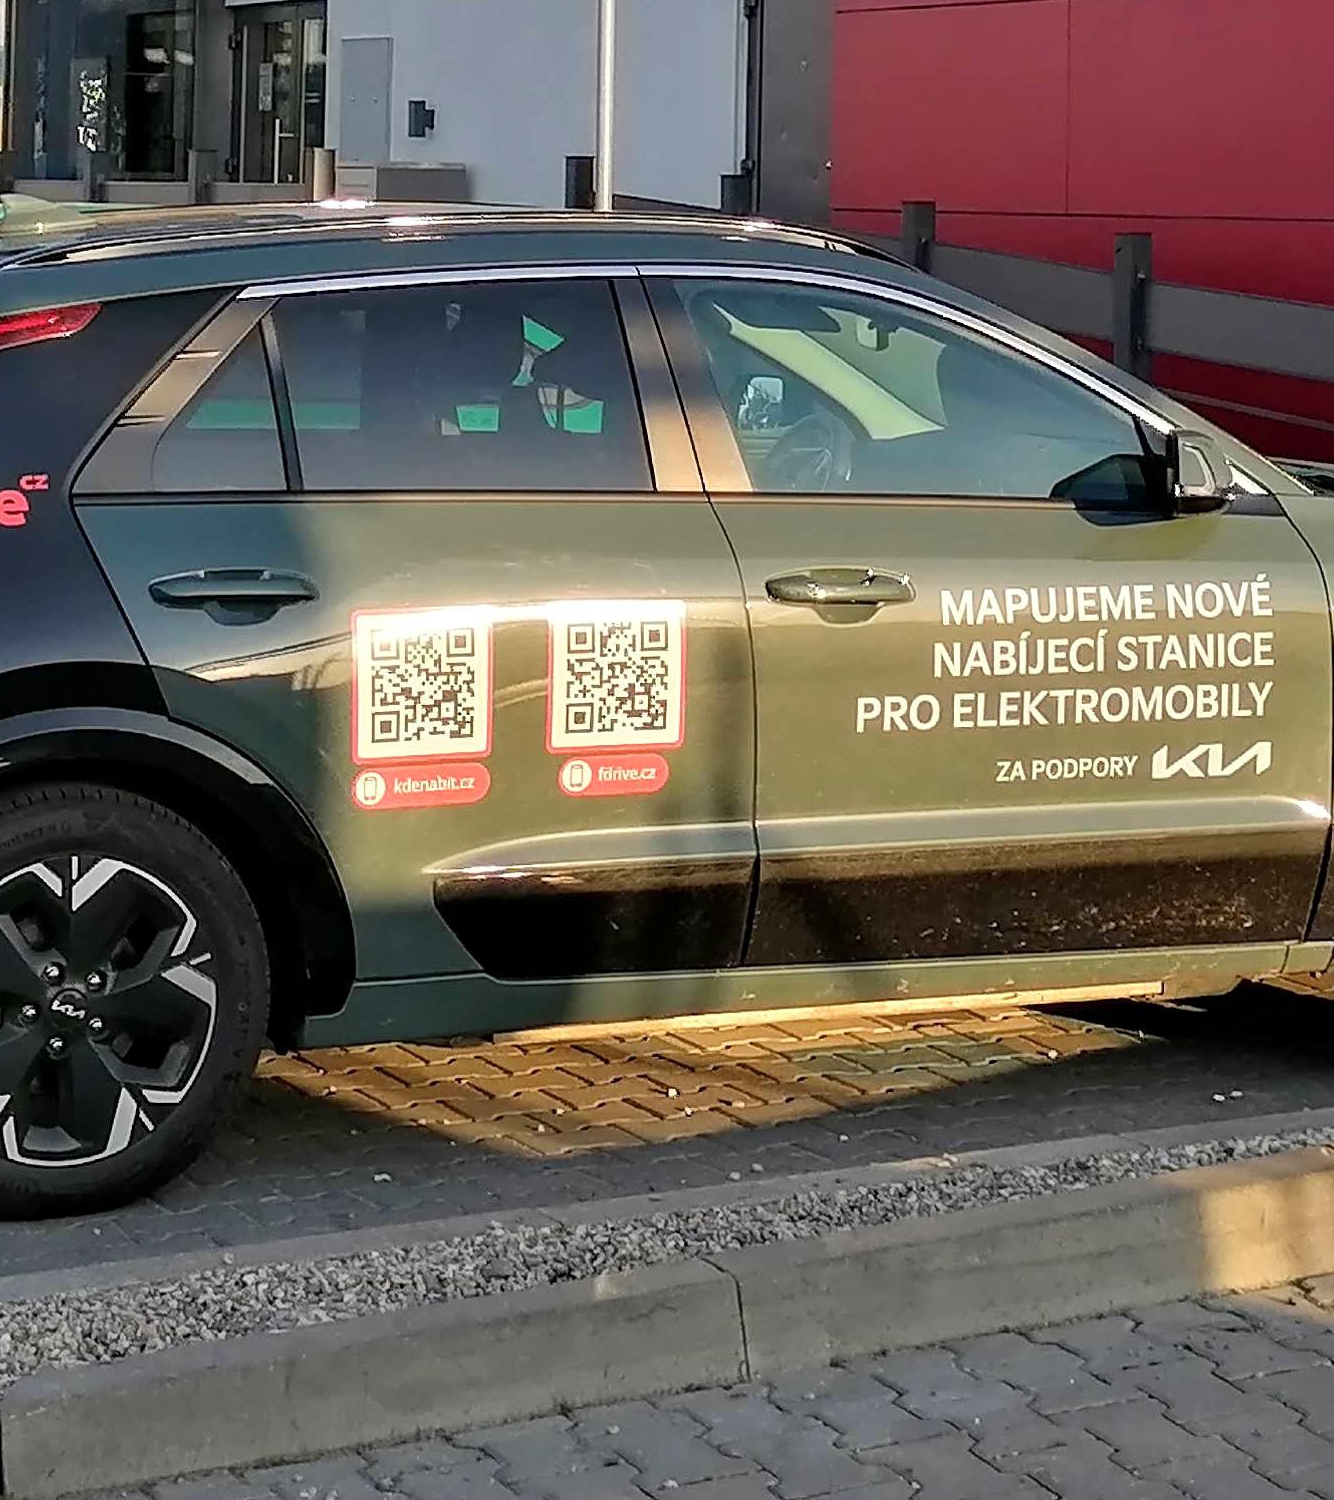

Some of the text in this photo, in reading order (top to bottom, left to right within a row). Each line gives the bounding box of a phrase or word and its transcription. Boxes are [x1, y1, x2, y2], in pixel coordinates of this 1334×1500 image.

[940, 574, 1273, 625] MAPUJEME NOVÉ
[933, 628, 1275, 678] NABÍJECÍ STANICE
[856, 681, 1273, 733] PRO ELEKTROMOBILY
[394, 775, 475, 794] kdenabit.cz
[995, 760, 1026, 782] ZA
[1032, 755, 1139, 780] PODPORY
